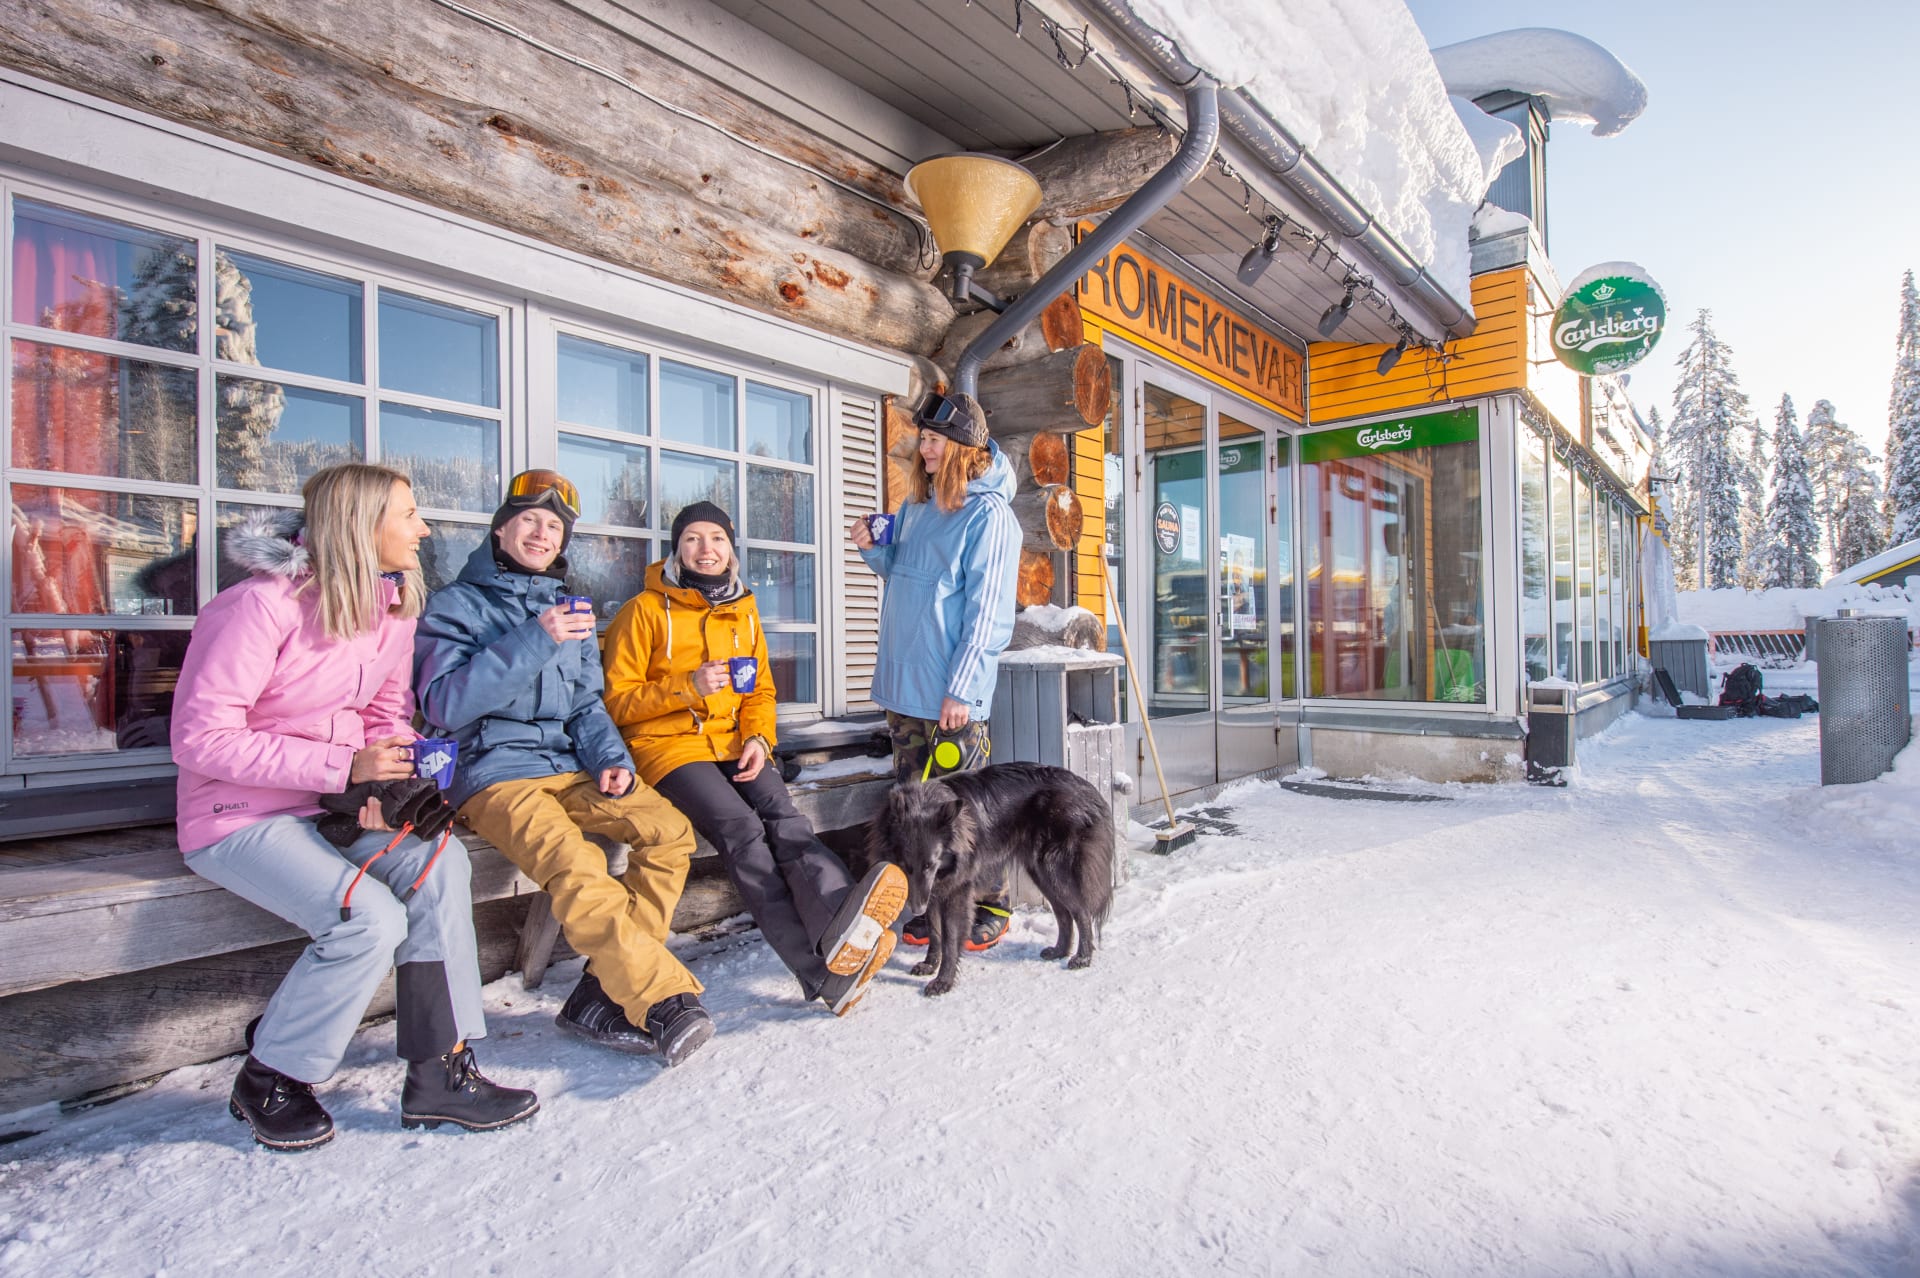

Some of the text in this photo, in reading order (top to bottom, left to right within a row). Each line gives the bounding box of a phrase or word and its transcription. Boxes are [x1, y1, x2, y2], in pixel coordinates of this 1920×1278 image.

[1555, 313, 1658, 352] Carlsberg
[1357, 427, 1412, 449] Carlsberg
[1157, 518, 1179, 533] SAUNA
